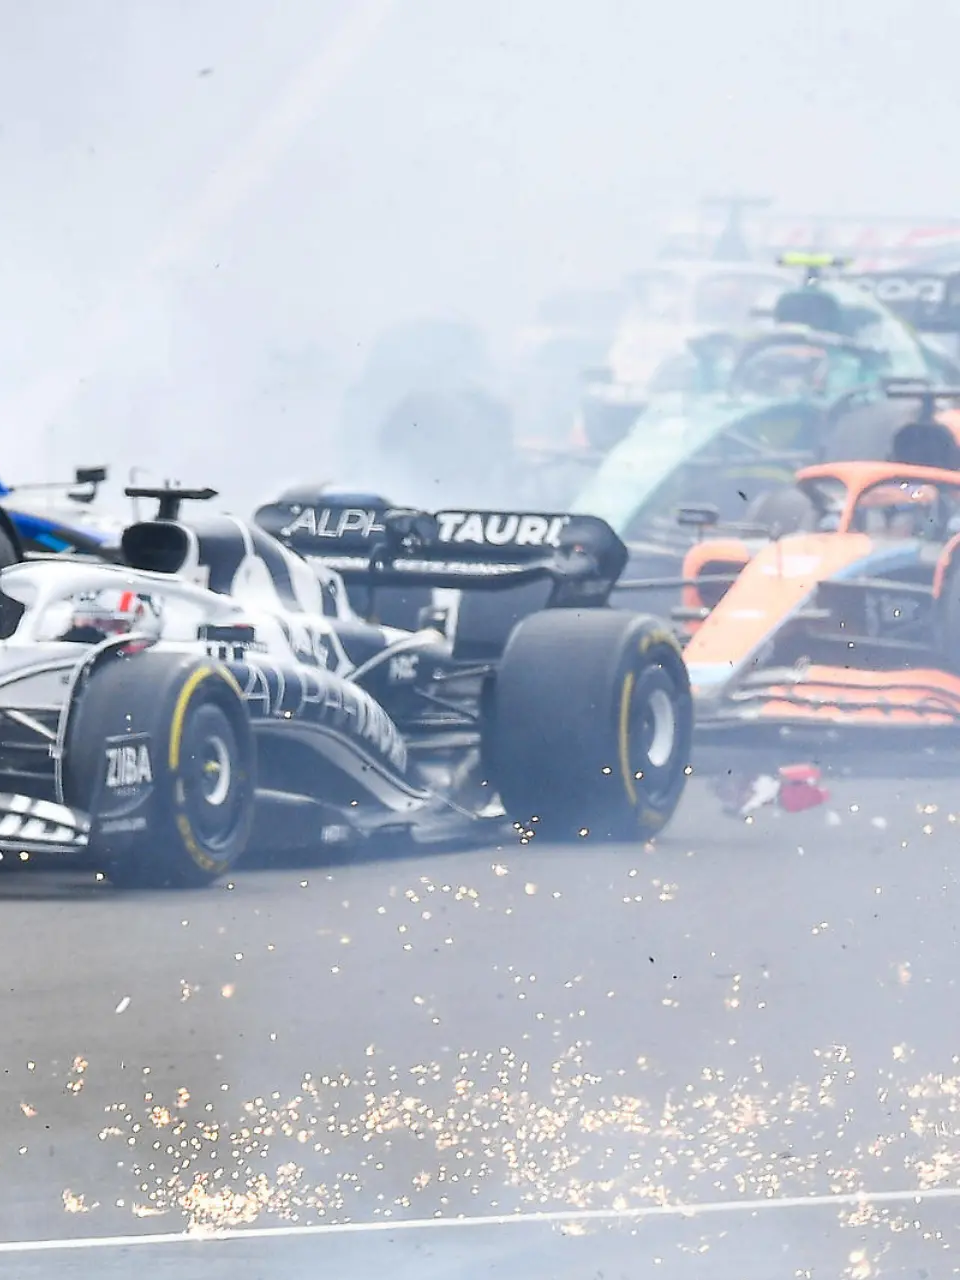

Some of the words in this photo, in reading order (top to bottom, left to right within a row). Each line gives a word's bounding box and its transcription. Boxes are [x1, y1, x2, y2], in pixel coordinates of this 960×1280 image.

[283, 507, 385, 538] ALPH
[438, 514, 562, 546] TAURI
[105, 745, 153, 787] ZIBA
